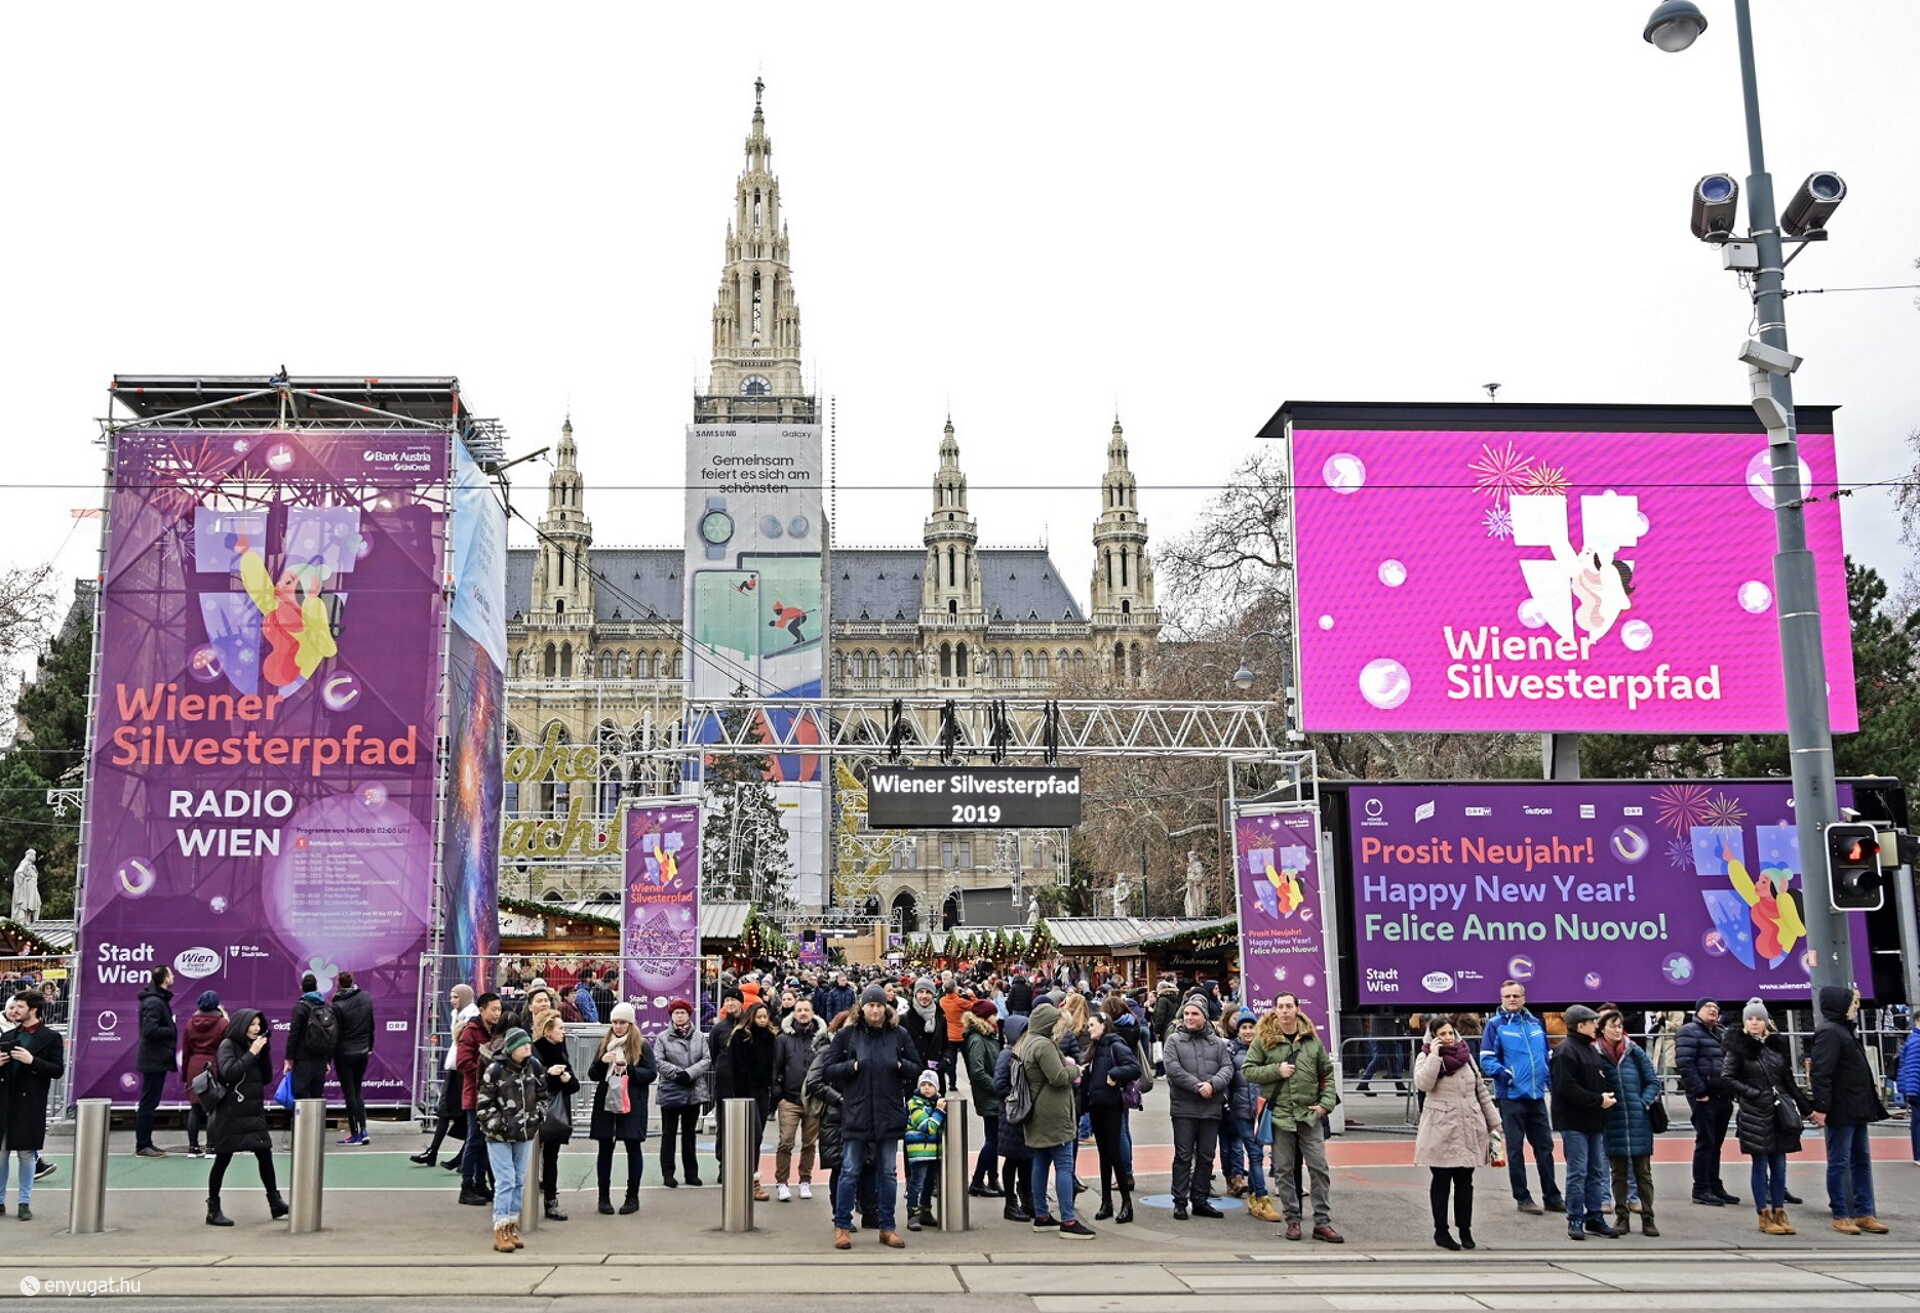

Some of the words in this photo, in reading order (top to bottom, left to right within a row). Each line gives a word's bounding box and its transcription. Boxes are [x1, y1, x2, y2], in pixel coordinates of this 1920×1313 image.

[782, 430, 812, 438] Galaxy
[375, 451, 399, 461] Bank
[400, 451, 431, 461] Austria
[712, 454, 794, 466] Gemeinsam
[701, 467, 737, 480] feiert
[740, 470, 756, 480] es
[758, 467, 785, 480] sich
[787, 470, 810, 480] am
[719, 482, 789, 494] schönsten
[1443, 625, 1598, 661] Wiener
[1446, 664, 1722, 711] Silvesterpfad
[116, 683, 284, 722] Wiener
[112, 725, 417, 777] Silvesterpfad
[871, 774, 946, 793] Wiener
[950, 774, 1080, 798] Silvesterpfad
[168, 788, 294, 818] RADIO
[951, 804, 1001, 823] 2019
[176, 829, 281, 857] WIEN
[1361, 836, 1453, 864] Prosit
[1460, 836, 1595, 872] Neujahr!
[631, 883, 665, 893] Wiener
[1363, 875, 1467, 911] Happy
[1475, 875, 1547, 902] New
[1553, 875, 1637, 902] Year!
[630, 891, 693, 904] Silvesterpfad
[1365, 913, 1455, 941] Felice
[1462, 913, 1548, 941] Anno
[1554, 912, 1669, 941] Nuovo!
[1195, 936, 1217, 952] Hot
[1249, 938, 1273, 947] Happy
[1292, 936, 1312, 944] Year!
[98, 943, 155, 962] Stadt
[1250, 946, 1270, 954] Felice
[1271, 946, 1291, 954] Anno
[181, 953, 214, 963] Wien
[97, 964, 153, 984] Wien
[1366, 967, 1399, 980] Stadt
[1426, 975, 1448, 983] Wien
[1366, 980, 1399, 992] Wien
[1253, 999, 1272, 1007] Stadt
